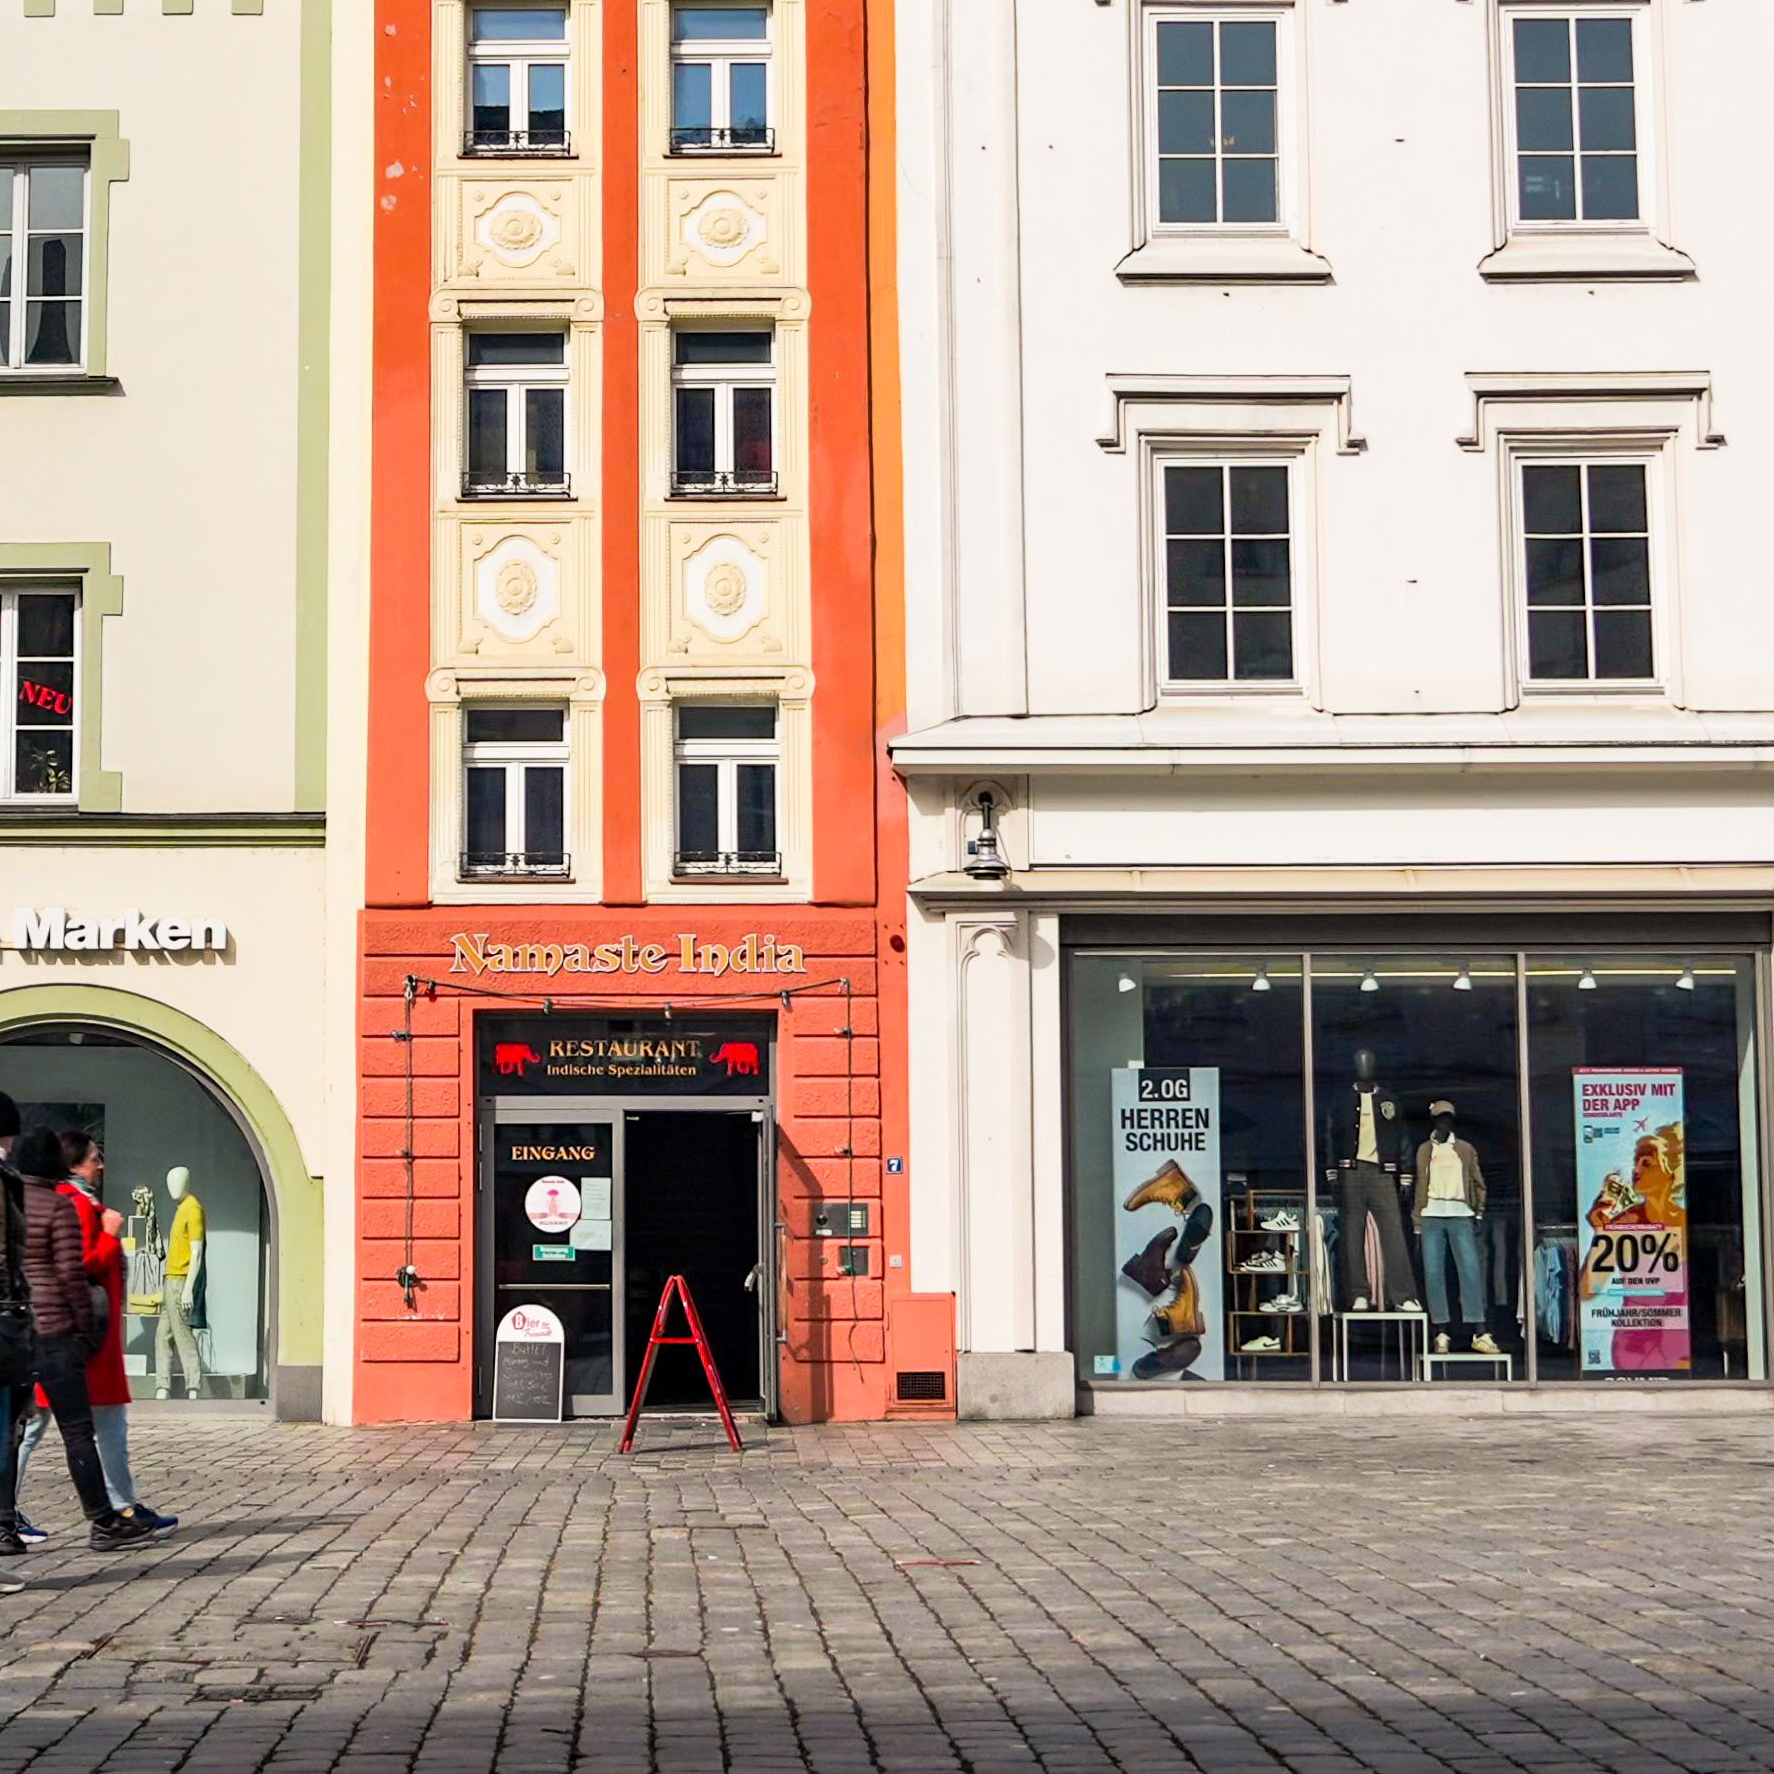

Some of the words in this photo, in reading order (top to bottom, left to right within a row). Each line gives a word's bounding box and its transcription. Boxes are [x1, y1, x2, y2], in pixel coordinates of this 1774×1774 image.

[19, 680, 73, 715] NEU
[13, 907, 228, 950] Marken
[449, 932, 667, 977] Namaste
[676, 932, 807, 977] India
[548, 1039, 701, 1059] RESTAURANT
[546, 1064, 605, 1076] Indische
[607, 1062, 697, 1078] Spezialitäten
[1582, 1083, 1647, 1096] EXKLUSIV
[1651, 1083, 1675, 1096] MIT
[1583, 1098, 1609, 1111] DER
[1613, 1098, 1640, 1111] APP
[1120, 1108, 1210, 1129] HERREN
[1125, 1132, 1206, 1151] SCHUHE
[511, 1145, 595, 1161] EINGANG
[889, 1159, 899, 1172] 7
[1591, 1306, 1681, 1317] FRÜHJAHR/SOMMER
[1611, 1318, 1663, 1328] KOLLEKTION
